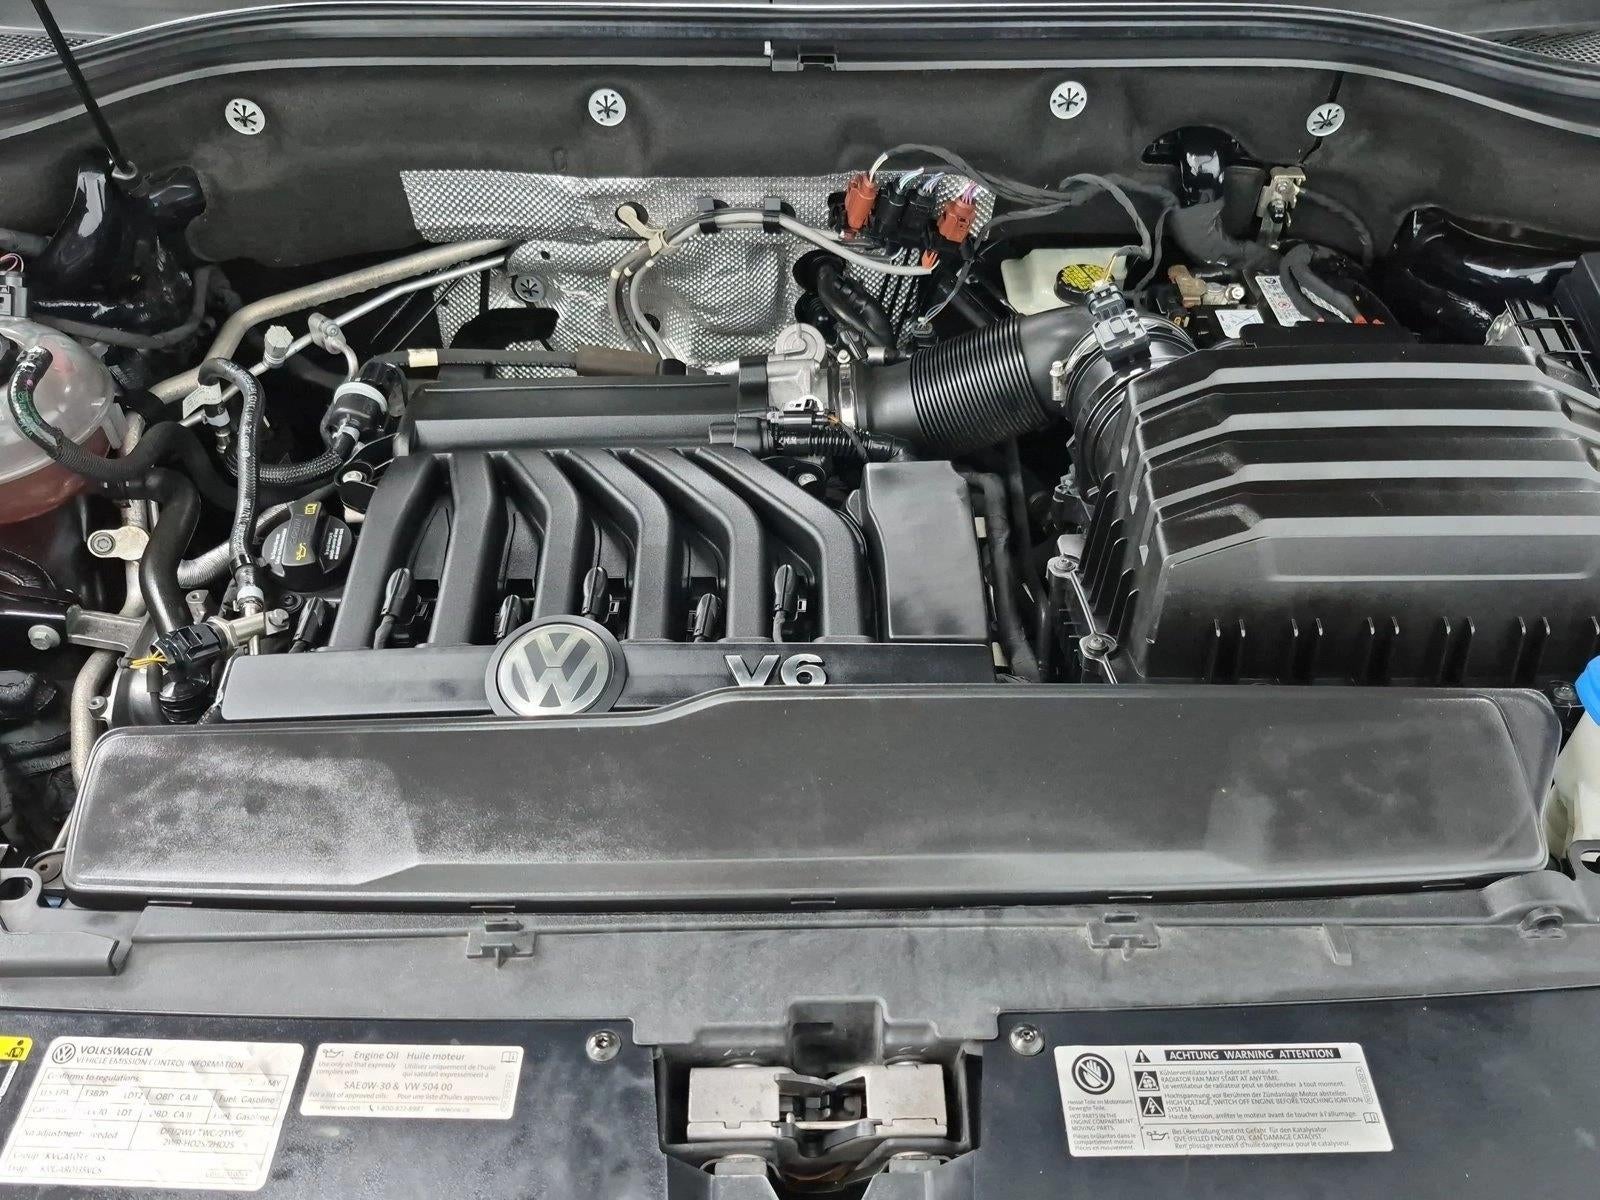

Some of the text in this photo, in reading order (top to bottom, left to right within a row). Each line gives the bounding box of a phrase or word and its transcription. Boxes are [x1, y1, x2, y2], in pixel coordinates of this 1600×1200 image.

[725, 653, 827, 686] V6
[80, 1046, 152, 1056] VOLKSWAGEN
[1169, 1049, 1334, 1060] ACHTUNG WARNING ATTENTION
[354, 1051, 399, 1061] Engine Oil
[406, 1052, 465, 1061] Huile moteur
[109, 1057, 146, 1066] EMISSION
[392, 1081, 400, 1091] &
[404, 1082, 421, 1091] VW
[1212, 1082, 1240, 1090] radiateur
[1240, 1083, 1255, 1091] peut
[1298, 1089, 1317, 1097] Motor
[1243, 1112, 1267, 1120] moteur
[1295, 1141, 1312, 1149] pour
